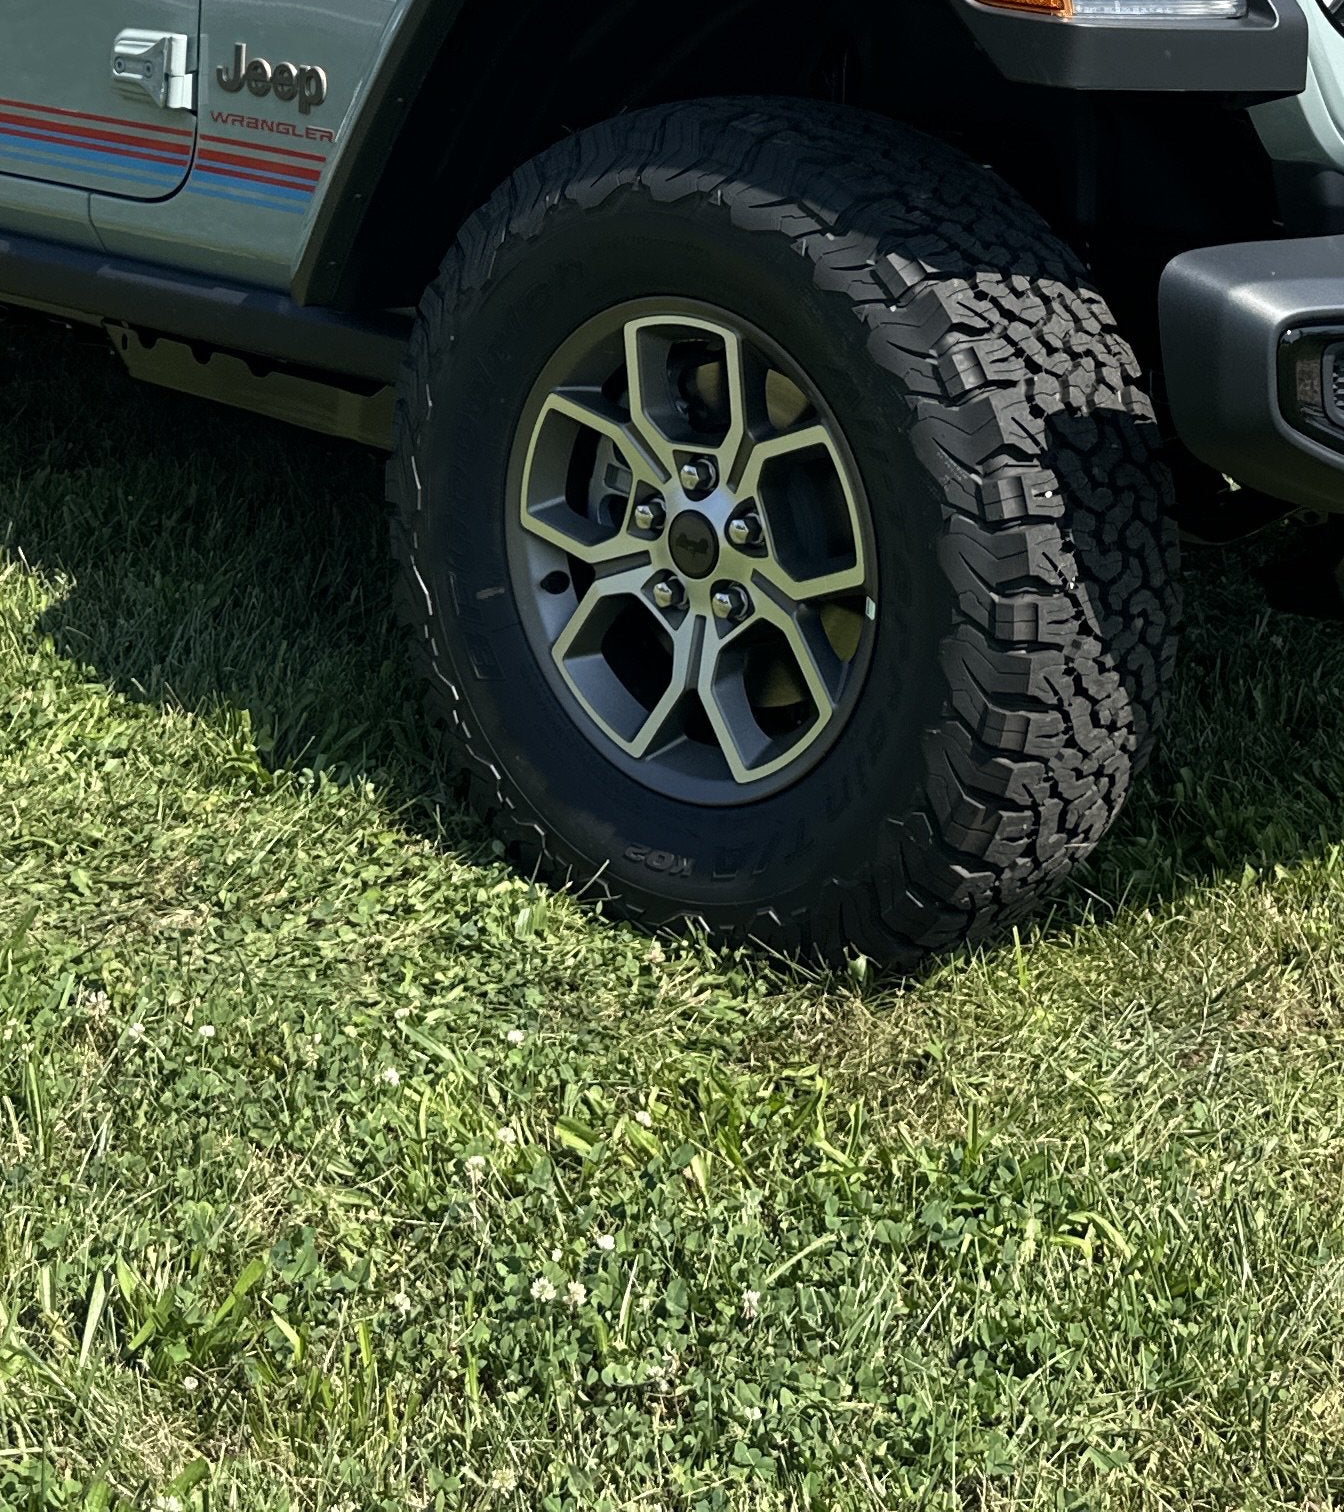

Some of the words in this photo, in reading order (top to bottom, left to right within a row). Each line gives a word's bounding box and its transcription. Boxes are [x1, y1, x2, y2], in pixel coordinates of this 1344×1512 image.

[217, 42, 327, 116] Jeep
[210, 110, 334, 144] WRANGLER
[623, 842, 693, 877] KO2
